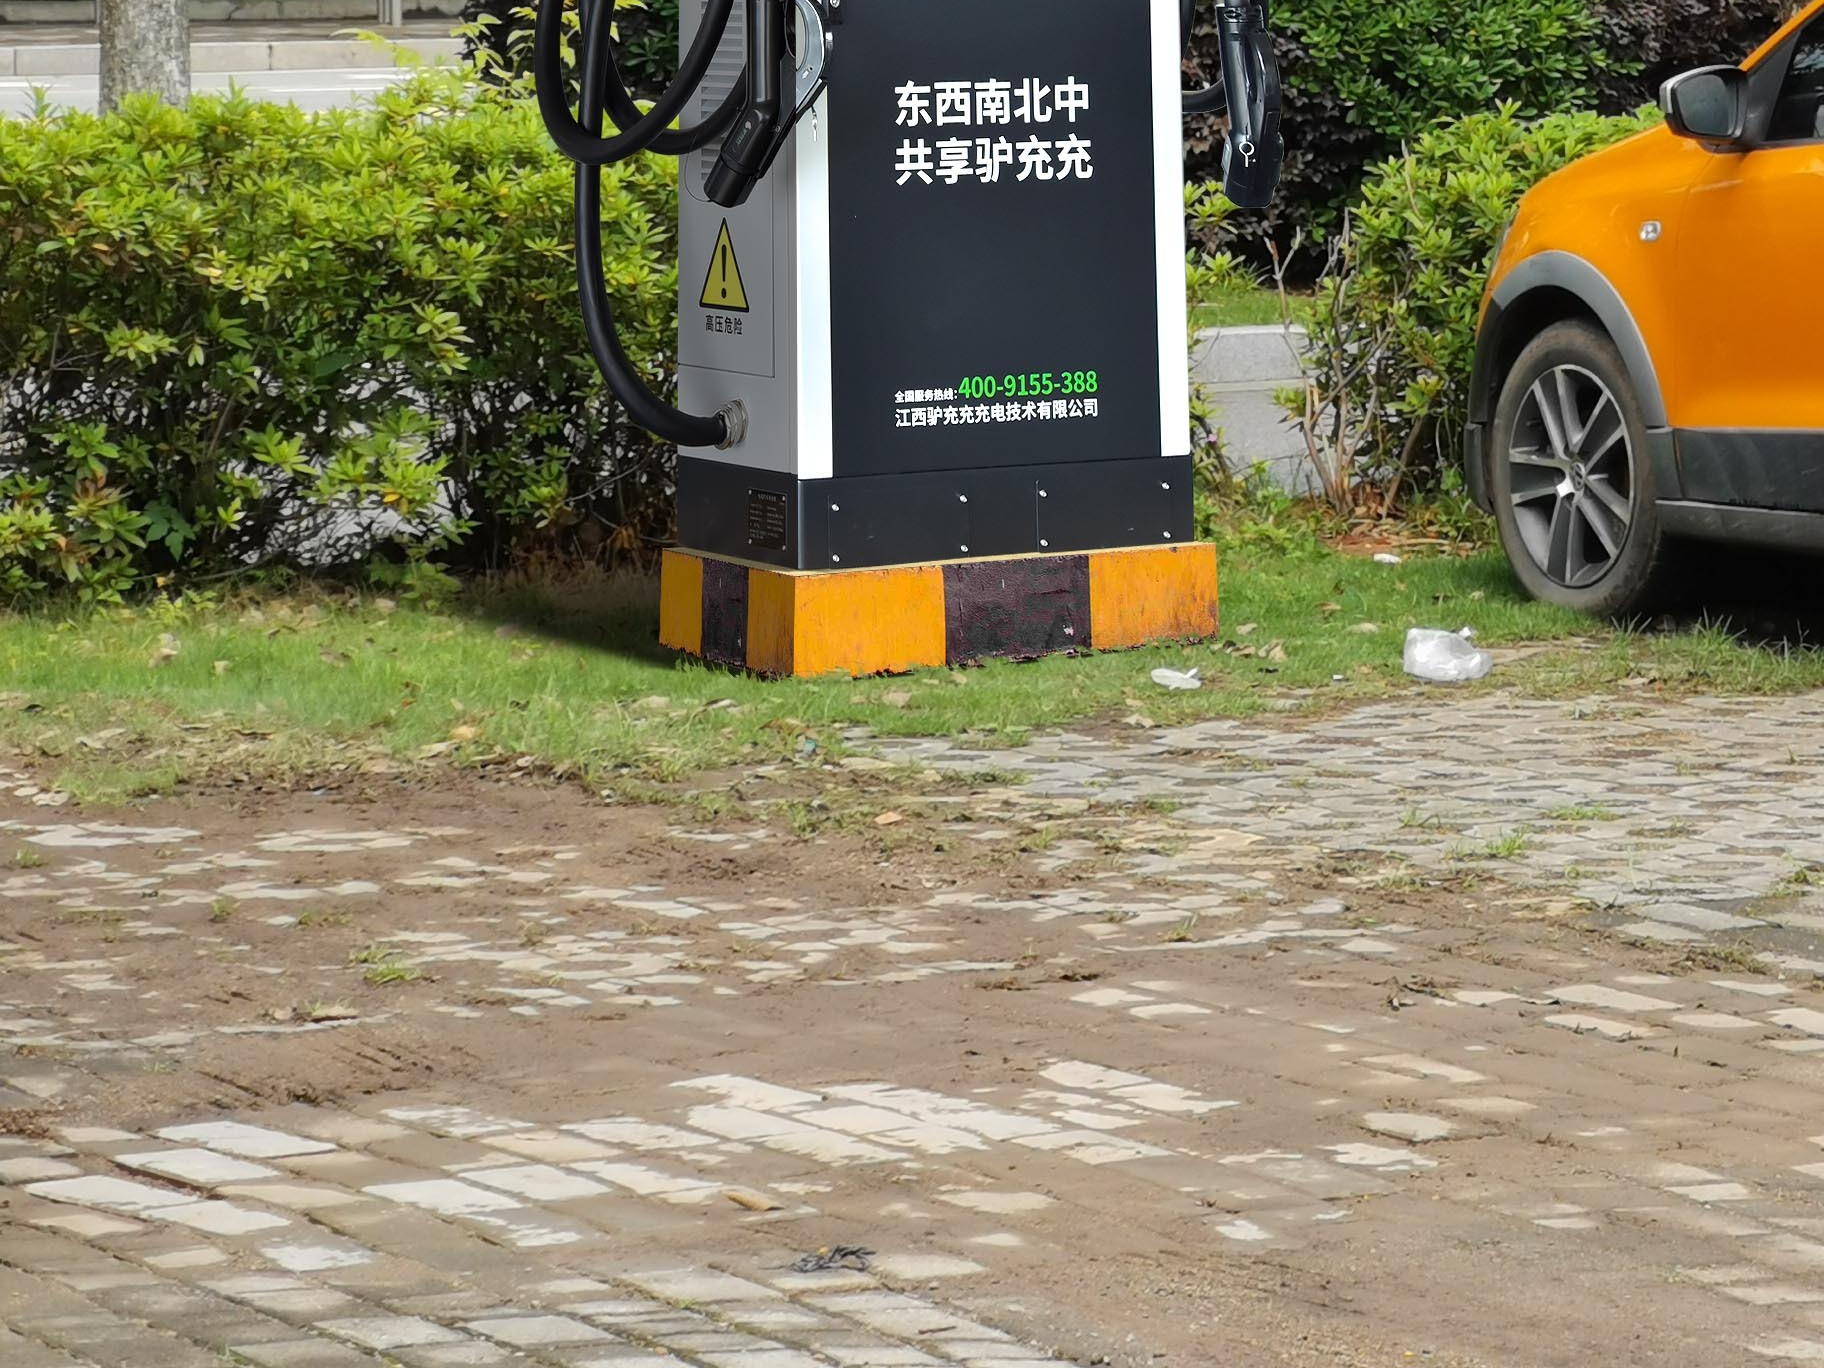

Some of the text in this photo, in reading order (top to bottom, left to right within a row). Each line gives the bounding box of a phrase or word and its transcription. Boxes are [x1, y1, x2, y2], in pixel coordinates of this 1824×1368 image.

[894, 75, 1090, 127] 东西南北中
[894, 133, 1094, 186] 共享驴充充
[705, 314, 743, 335] 高压危险
[959, 370, 1099, 399] 400-9155-388
[894, 398, 1099, 428] 江西驴充充充电技术有限公司
